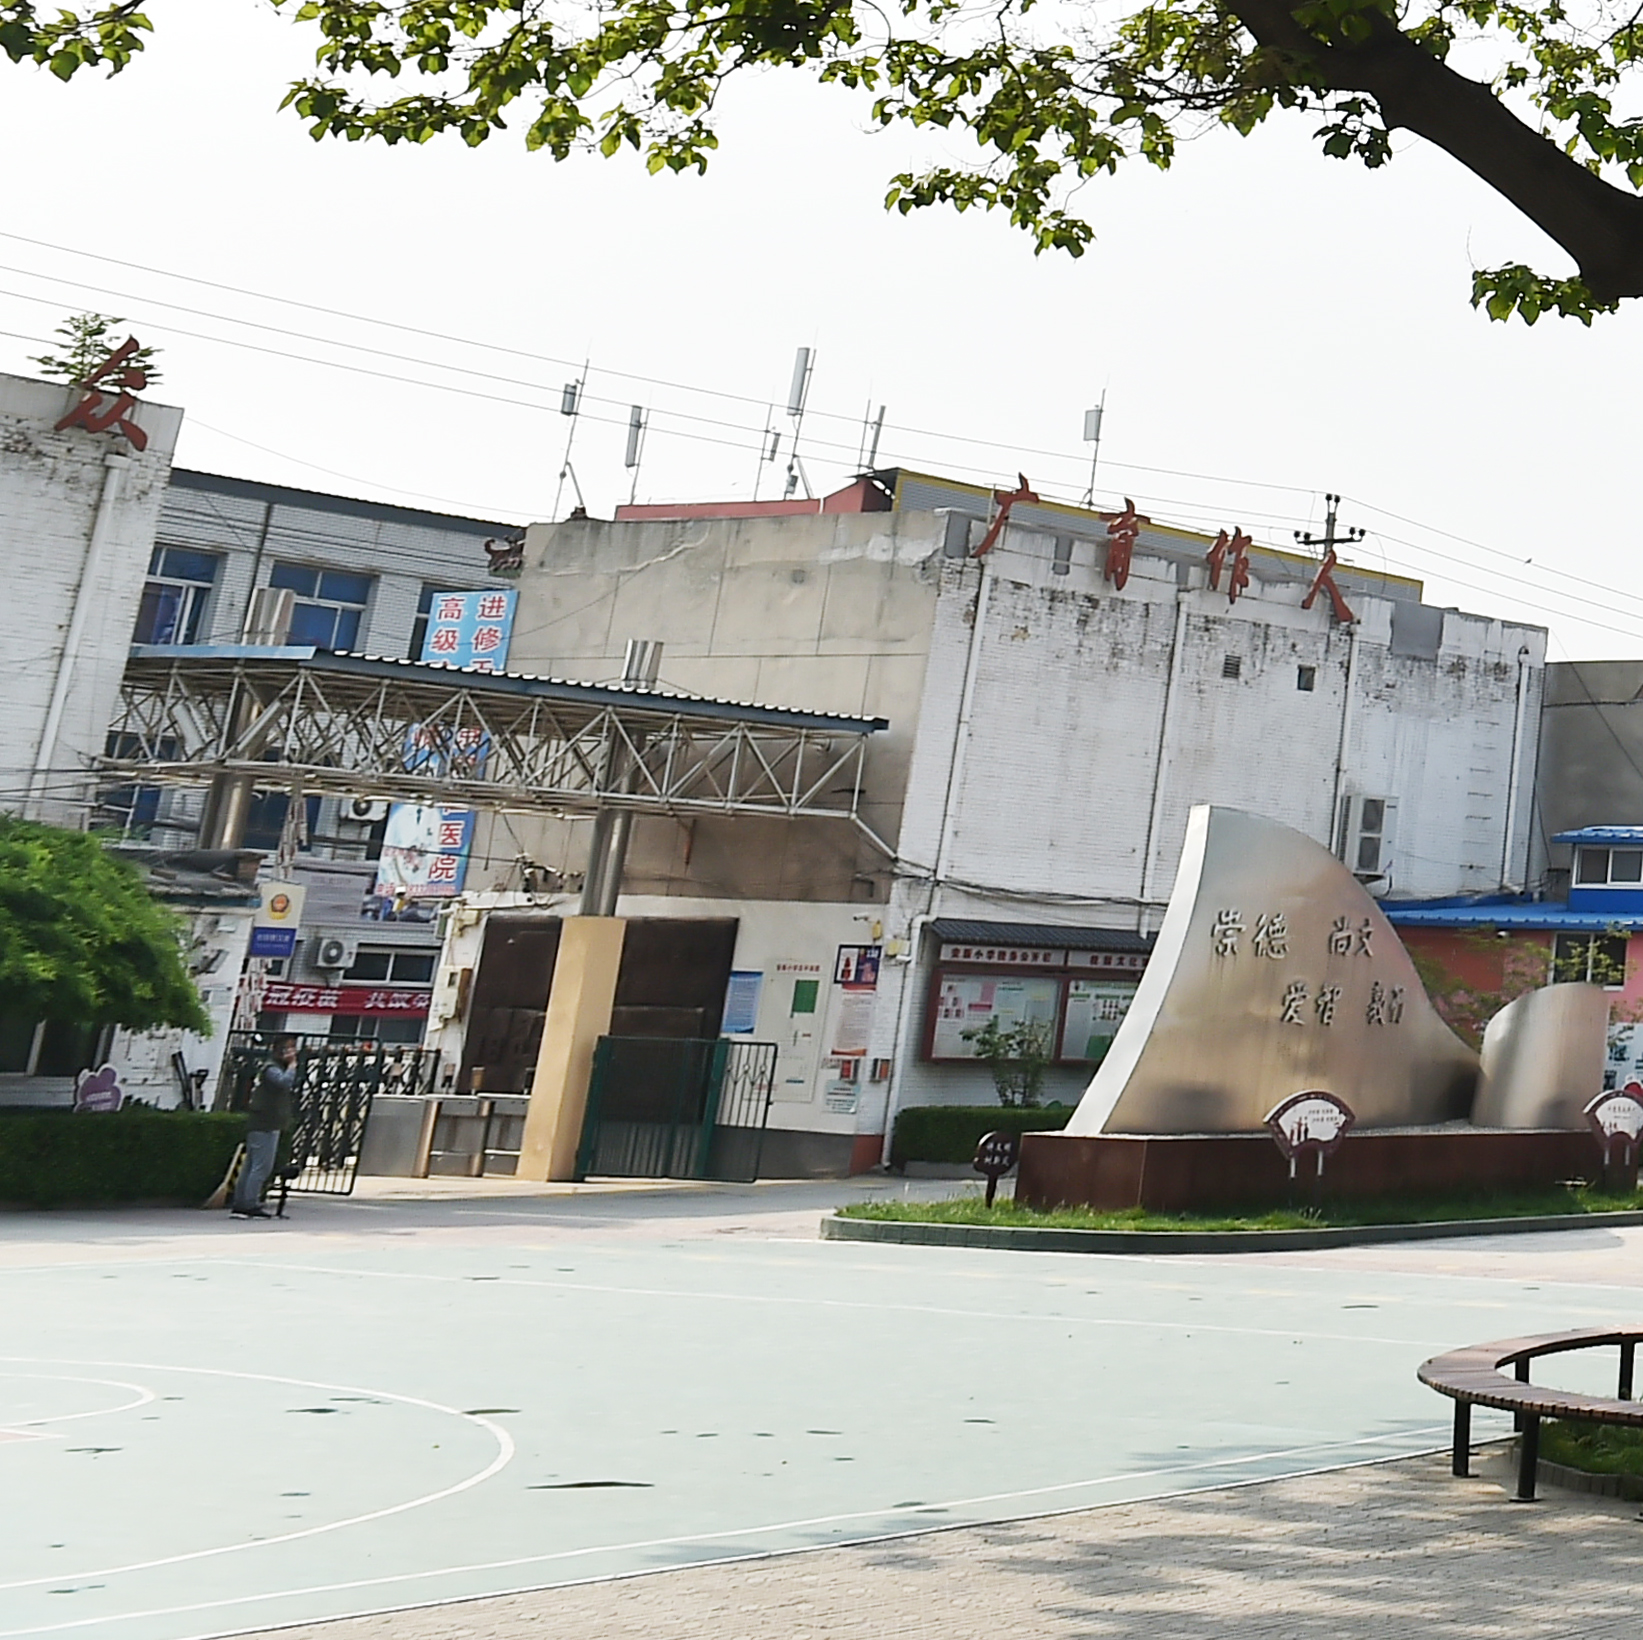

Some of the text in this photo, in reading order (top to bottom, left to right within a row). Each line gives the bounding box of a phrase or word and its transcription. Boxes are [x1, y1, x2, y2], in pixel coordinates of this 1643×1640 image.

[431, 597, 465, 666] 高级
[429, 806, 465, 880] 医院
[1211, 909, 1375, 959] 崇德 尚文
[1281, 980, 1343, 1026] 爱智
